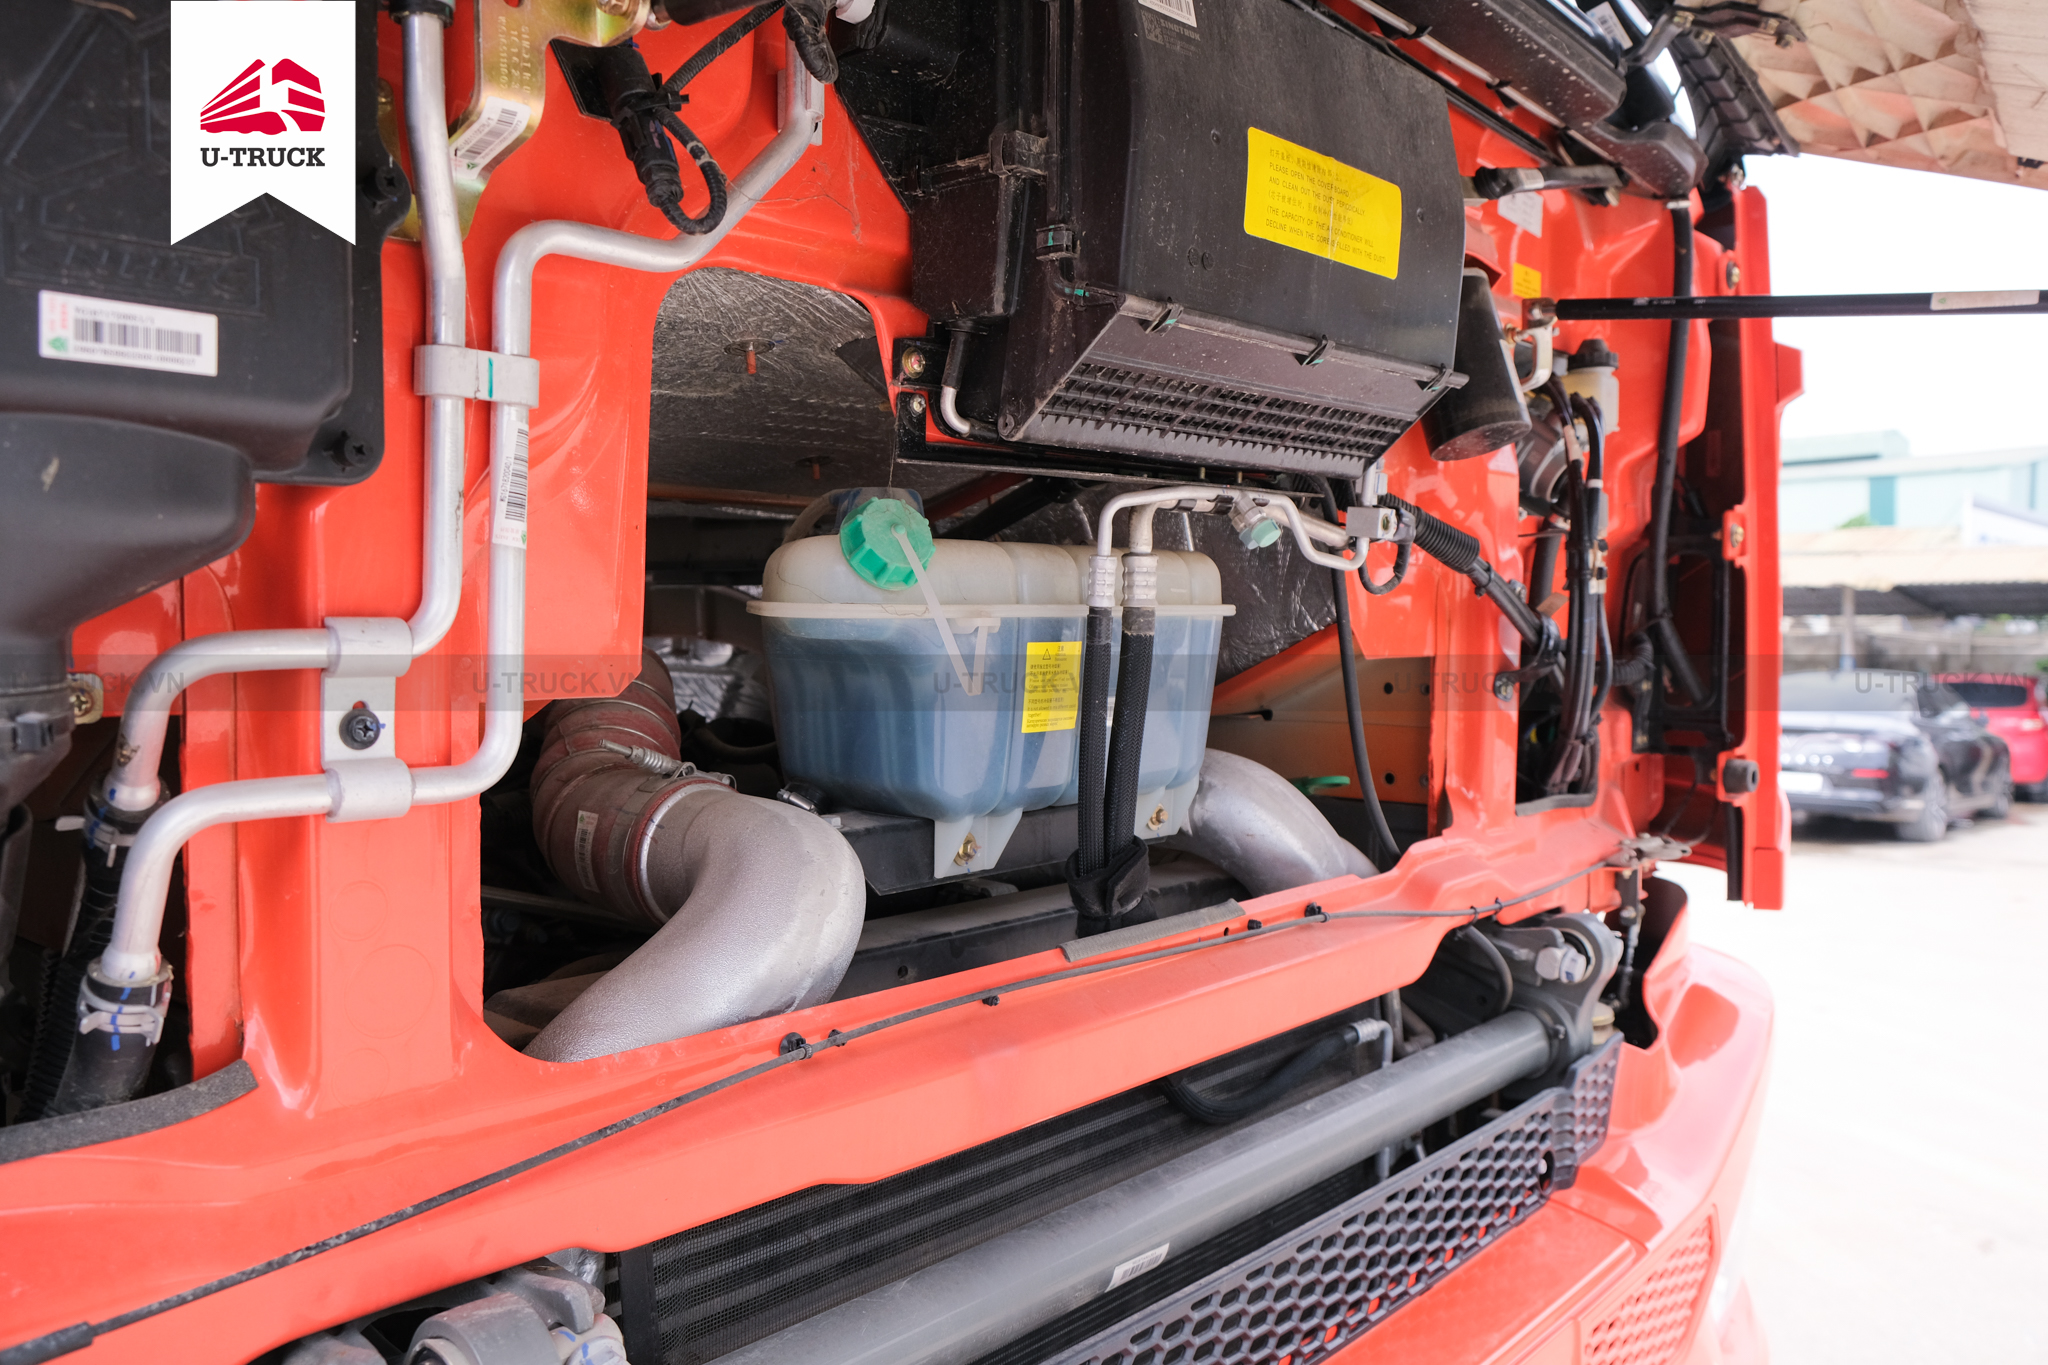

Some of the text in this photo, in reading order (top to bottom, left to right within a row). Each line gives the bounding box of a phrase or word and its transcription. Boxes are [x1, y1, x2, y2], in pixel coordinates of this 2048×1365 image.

[1269, 162, 1288, 175] PLEASE
[1290, 170, 1304, 181] OPEN
[1306, 175, 1315, 184] THE
[1268, 176, 1279, 185] AND
[1282, 181, 1298, 192] CLEAN
[1300, 187, 1309, 196] OUT
[1312, 191, 1320, 200] THE
[1266, 205, 1278, 217] (THE
[1281, 210, 1305, 224] CAPACITY
[1306, 218, 1313, 226] OF
[1315, 221, 1325, 231] THE
[1265, 219, 1286, 232] DECLINE
[1289, 226, 1303, 237] WHEN
[1305, 231, 1314, 240] THE
[1316, 234, 1329, 245] CORE
[1336, 241, 1350, 252] FILLED
[1352, 247, 1362, 256] WITH
